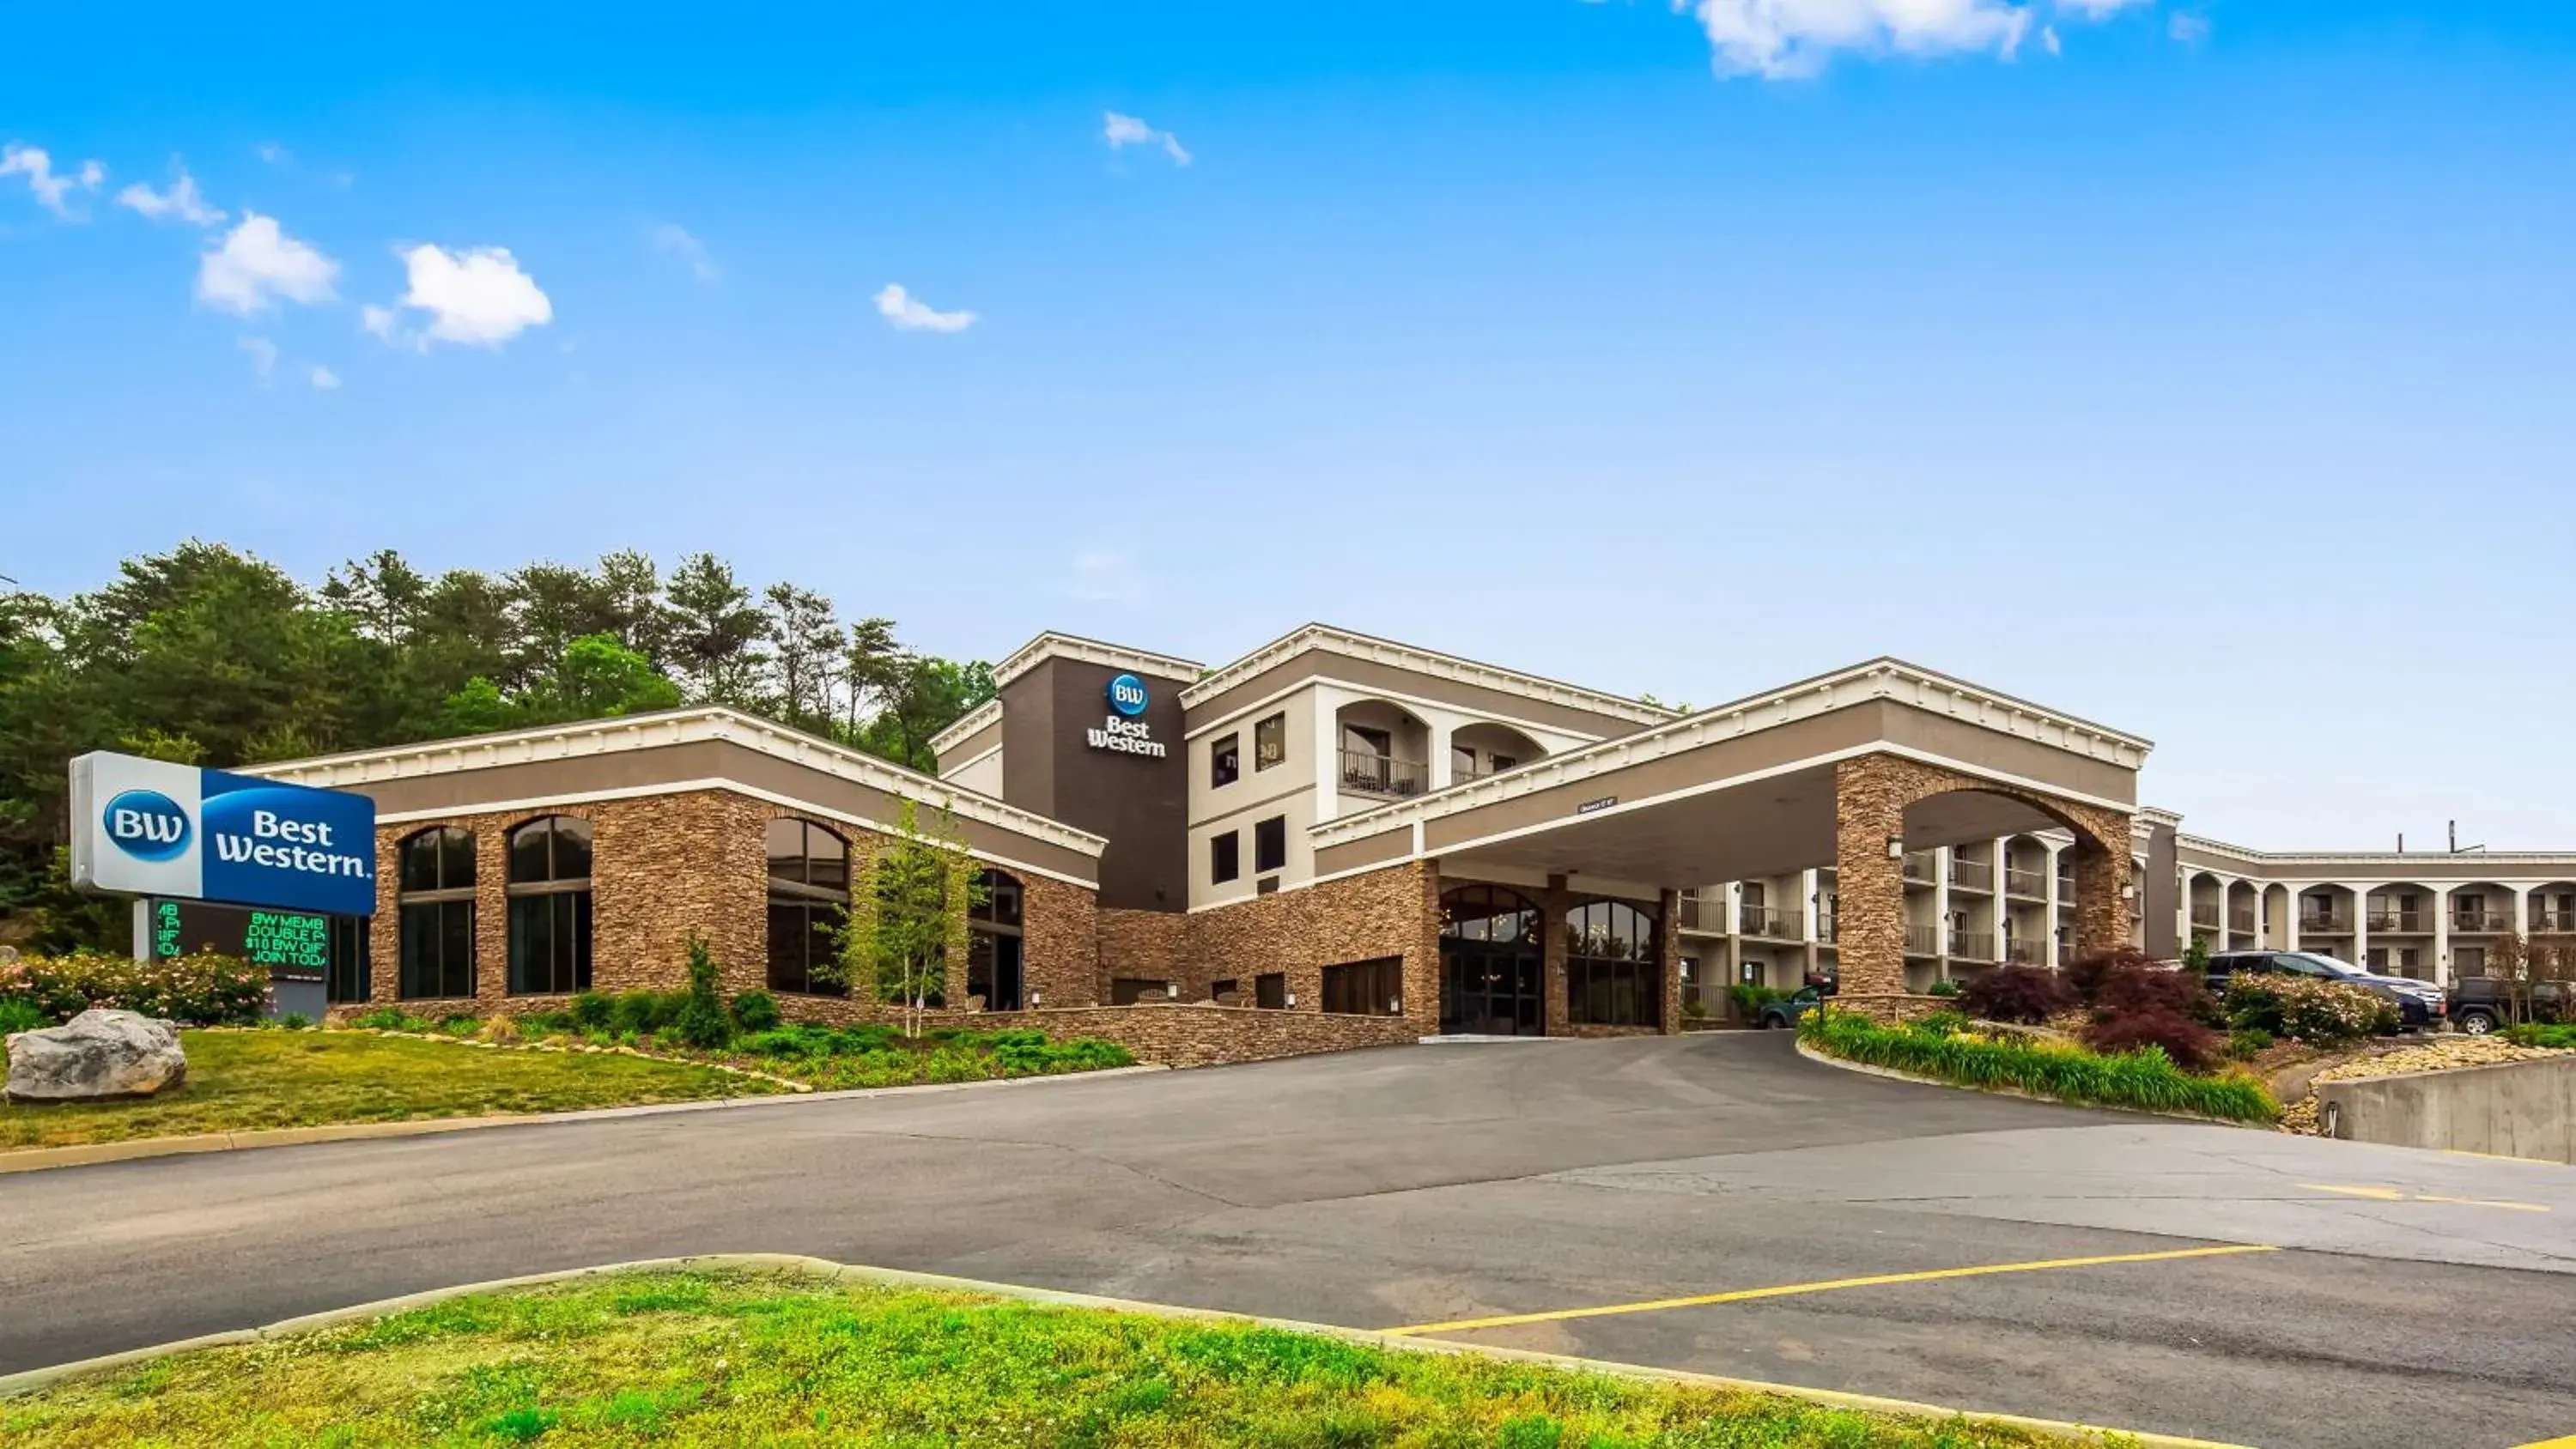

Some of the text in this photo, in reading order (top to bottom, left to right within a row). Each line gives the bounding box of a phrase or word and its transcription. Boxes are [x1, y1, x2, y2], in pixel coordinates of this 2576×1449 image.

[1115, 684, 1143, 704] BW
[1106, 715, 1150, 739] Best
[1086, 728, 1166, 757] Western
[114, 809, 183, 843] BW
[253, 810, 333, 846] Best
[252, 912, 278, 925] BW
[248, 925, 309, 941] DOUBLE
[272, 938, 298, 952] BW
[252, 949, 286, 963] JOIN
